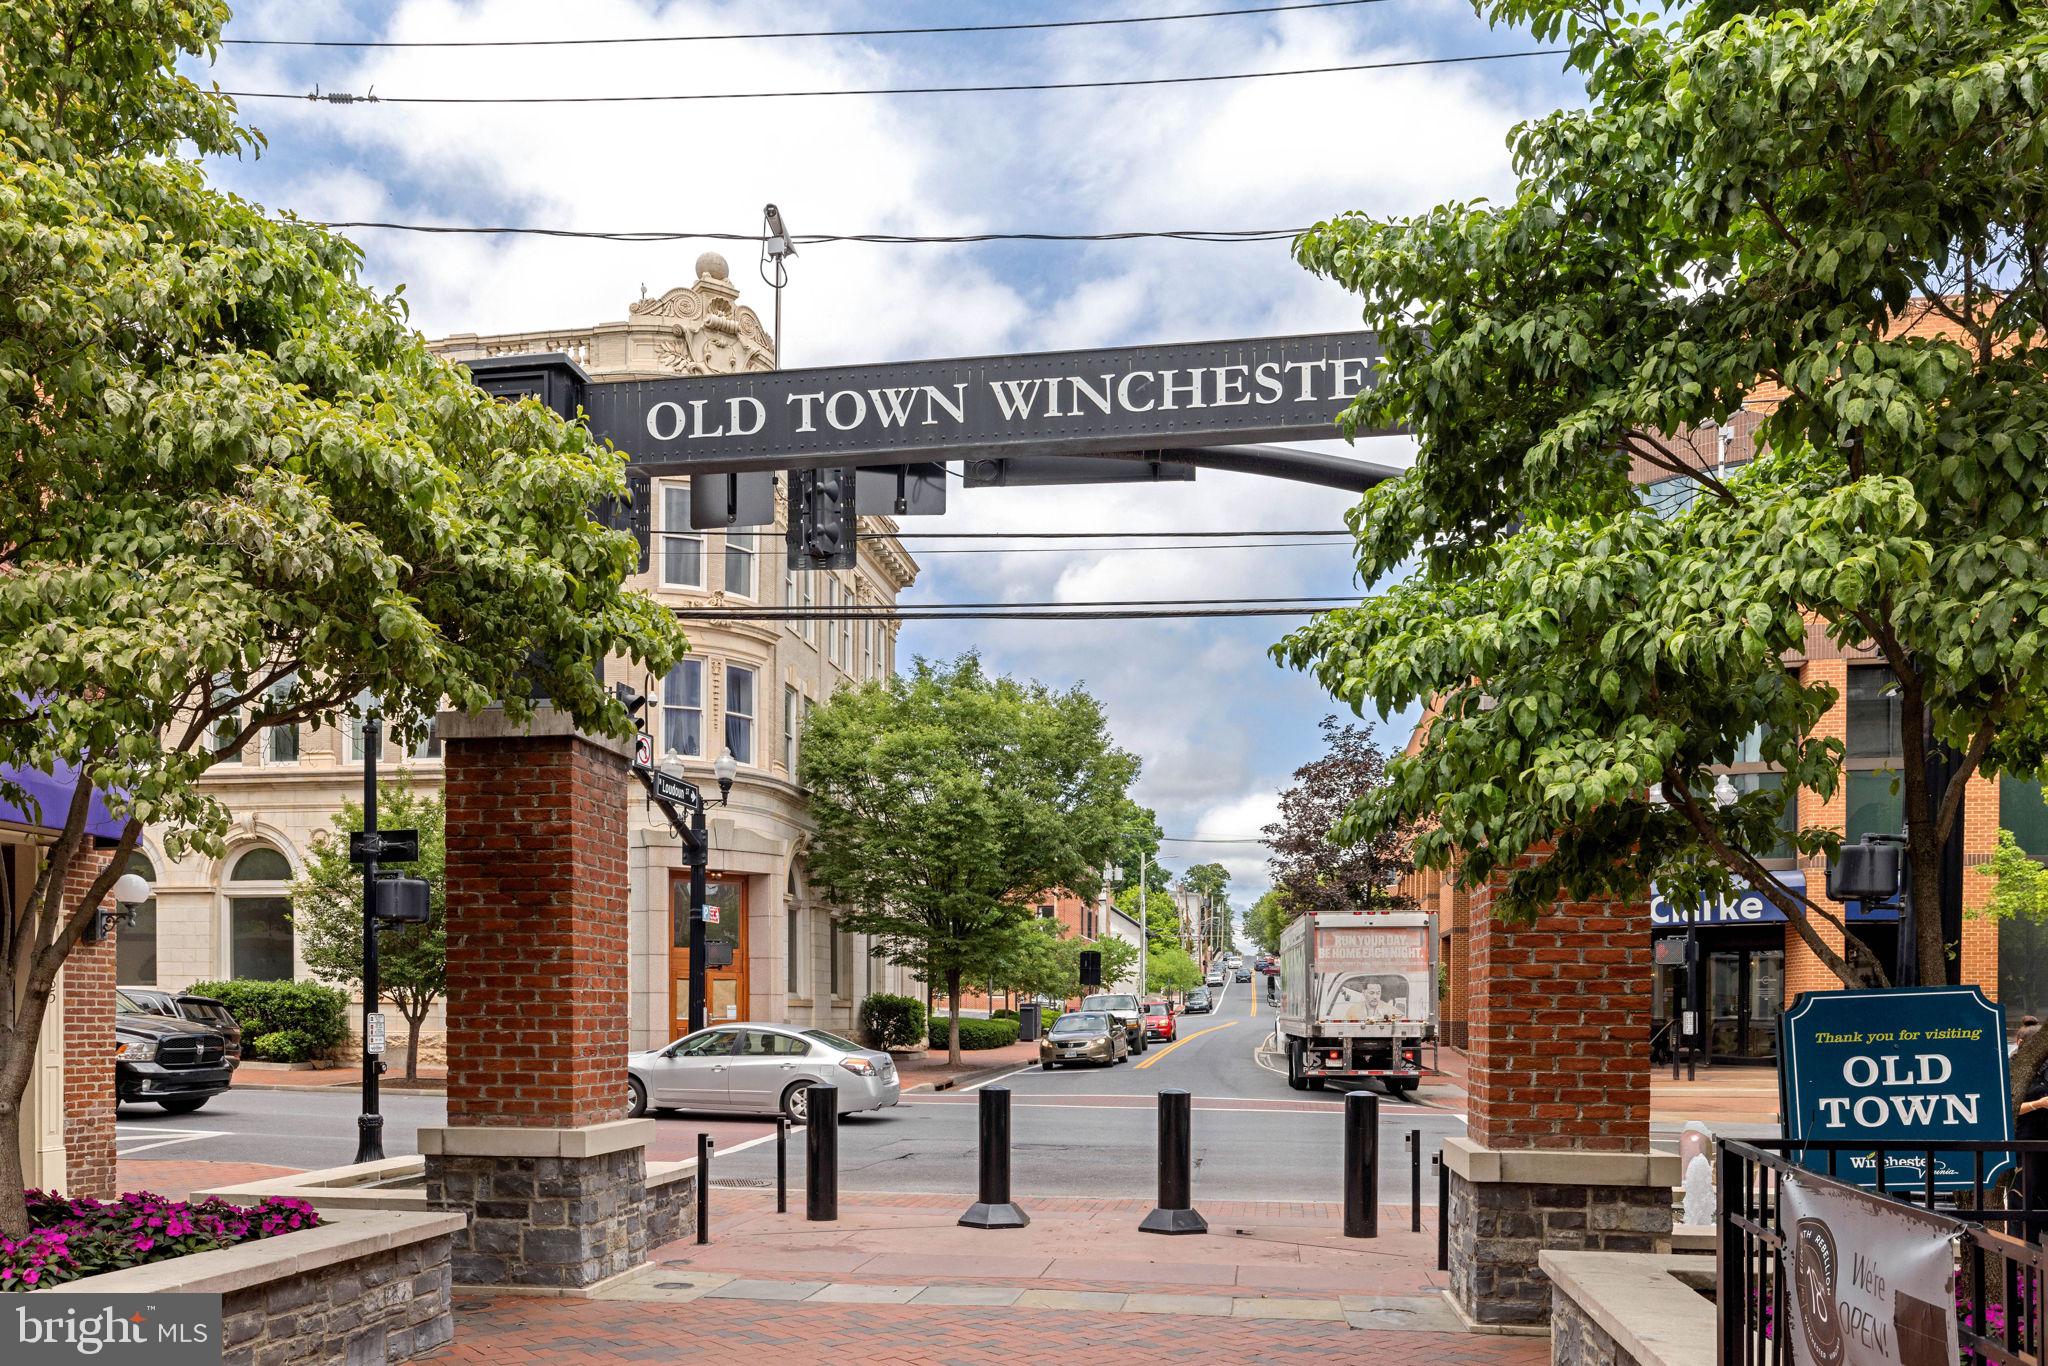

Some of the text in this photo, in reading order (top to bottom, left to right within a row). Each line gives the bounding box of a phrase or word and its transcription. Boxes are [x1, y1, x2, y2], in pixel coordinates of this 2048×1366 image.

[646, 356, 1399, 441] OLD TOWN WINCHESTE
[662, 779, 685, 800] Loudoun
[1319, 948, 1331, 959] BE
[1332, 948, 1361, 959] HOME
[1363, 948, 1389, 959] EACH
[1334, 935, 1357, 946] RUN
[1358, 935, 1385, 946] YOUR
[1815, 1027, 1983, 1045] Thank you for visiting
[1843, 1053, 1952, 1087] OLD
[1818, 1093, 1981, 1128] TOWN
[1815, 1234, 1831, 1296] REBELLION
[1852, 1251, 1885, 1301] We're
[1839, 1301, 1889, 1358] OPEN!
